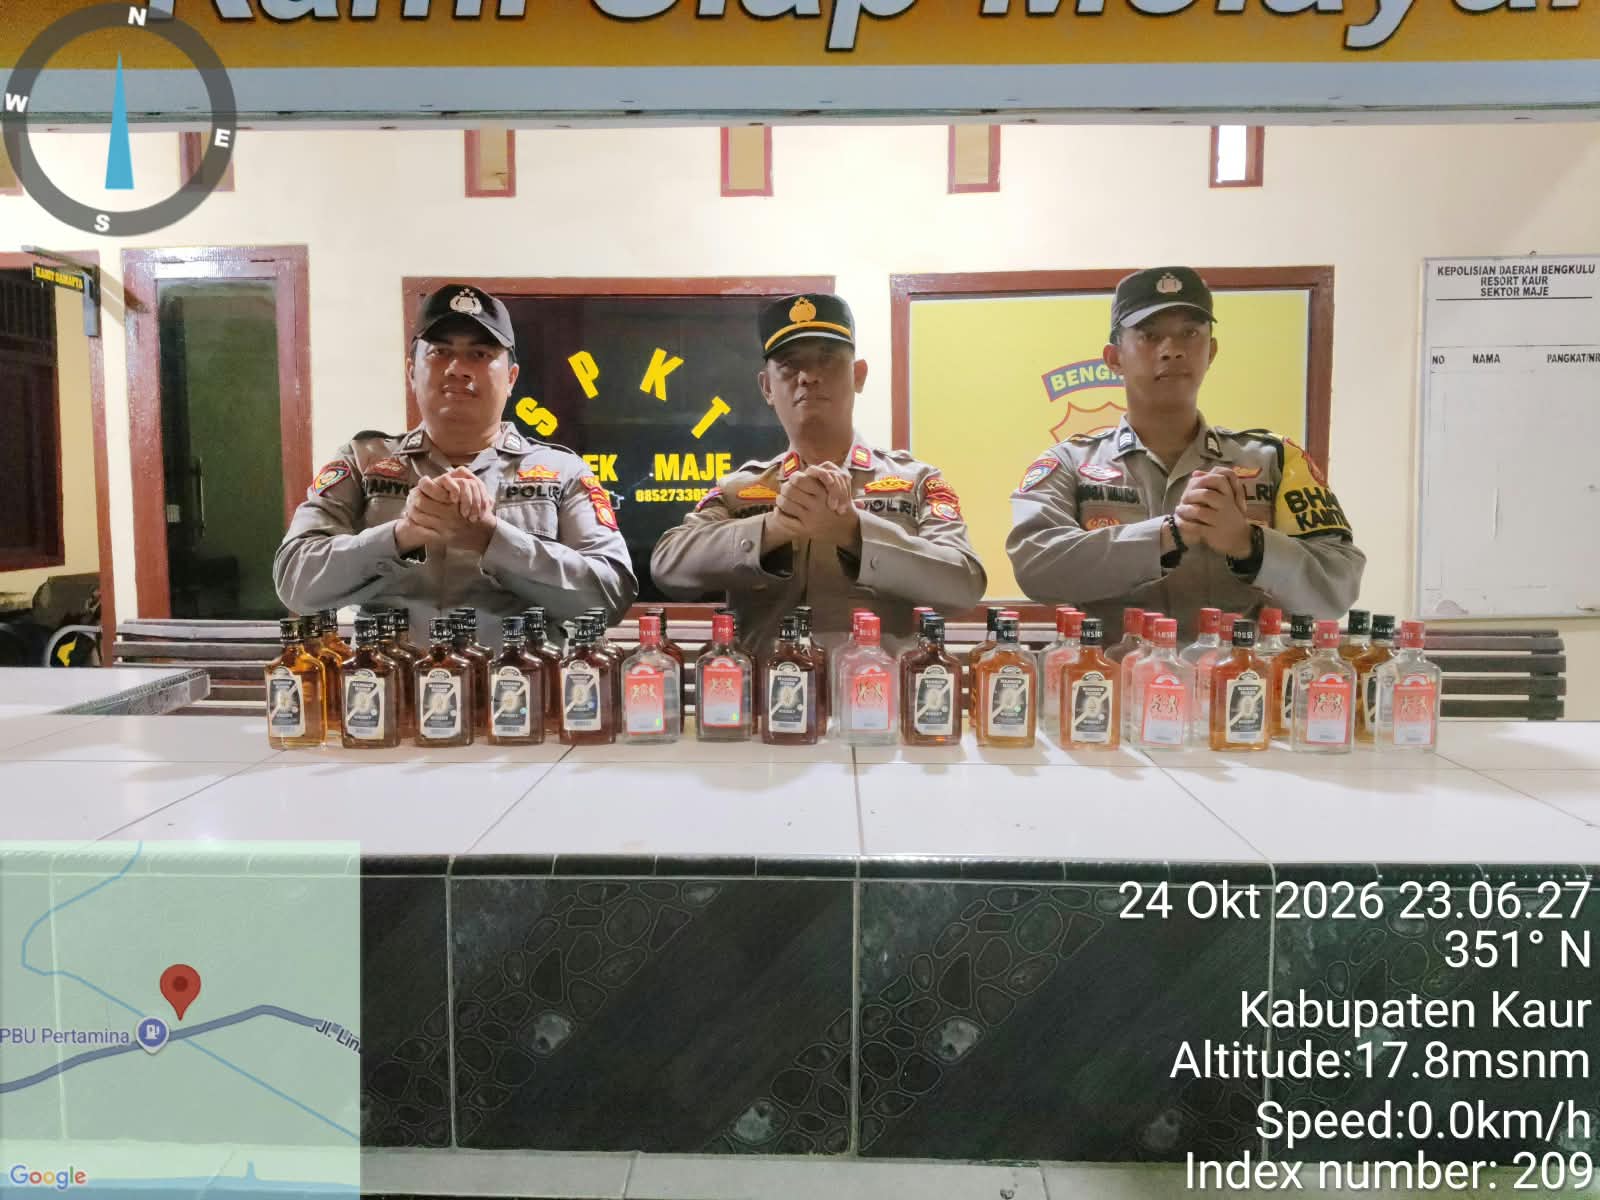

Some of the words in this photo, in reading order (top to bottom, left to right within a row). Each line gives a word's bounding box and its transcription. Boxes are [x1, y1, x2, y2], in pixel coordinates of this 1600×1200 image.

[1437, 265, 1496, 276] KEPOLISIAN
[1499, 265, 1539, 275] DAERAH
[1541, 264, 1596, 275] BENGKULU
[1480, 276, 1519, 286] RESORT
[1521, 275, 1549, 286] KAUR
[1480, 287, 1520, 297] SEKTOR
[1522, 286, 1549, 297] MAJE
[1432, 355, 1445, 365] NO
[1472, 353, 1501, 364] NAMA
[654, 453, 732, 481] MAJE
[635, 488, 710, 502] 085273305
